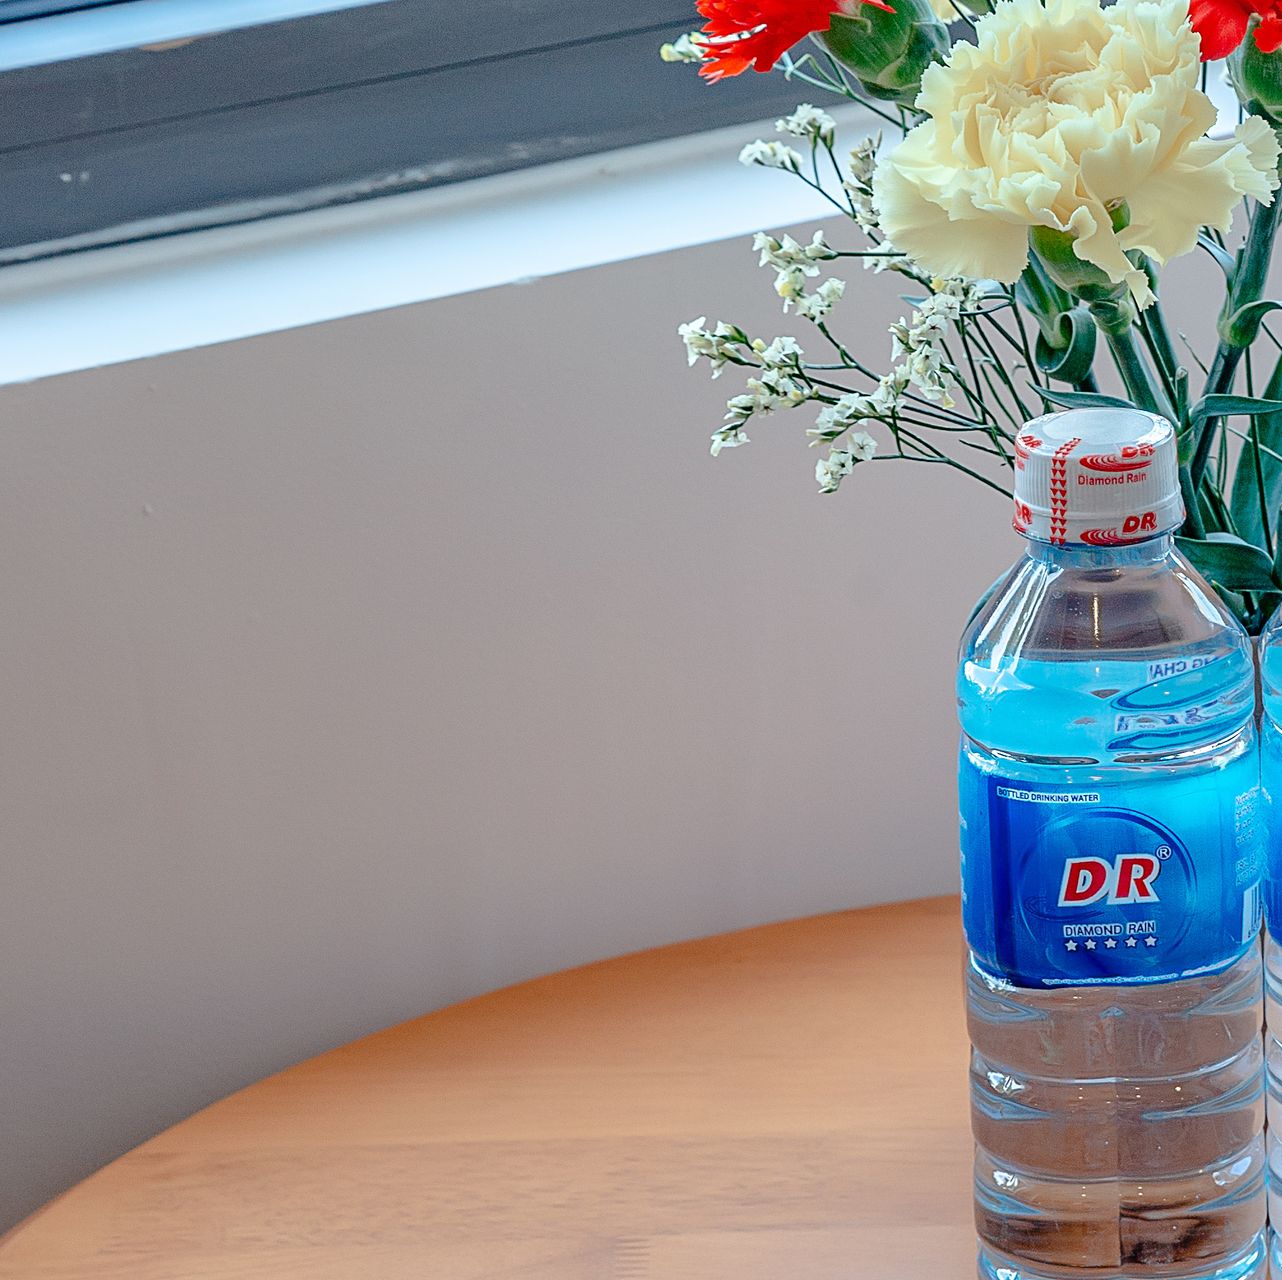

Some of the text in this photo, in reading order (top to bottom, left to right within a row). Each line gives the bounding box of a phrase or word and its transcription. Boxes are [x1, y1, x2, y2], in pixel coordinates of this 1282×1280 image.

[1077, 472, 1147, 486] Diamond Rain
[1121, 511, 1157, 534] DR
[997, 786, 1099, 803] BOTTLED DRINKING WATER
[1058, 854, 1160, 906] DR
[1064, 921, 1156, 937] DIAMOND RAIN
